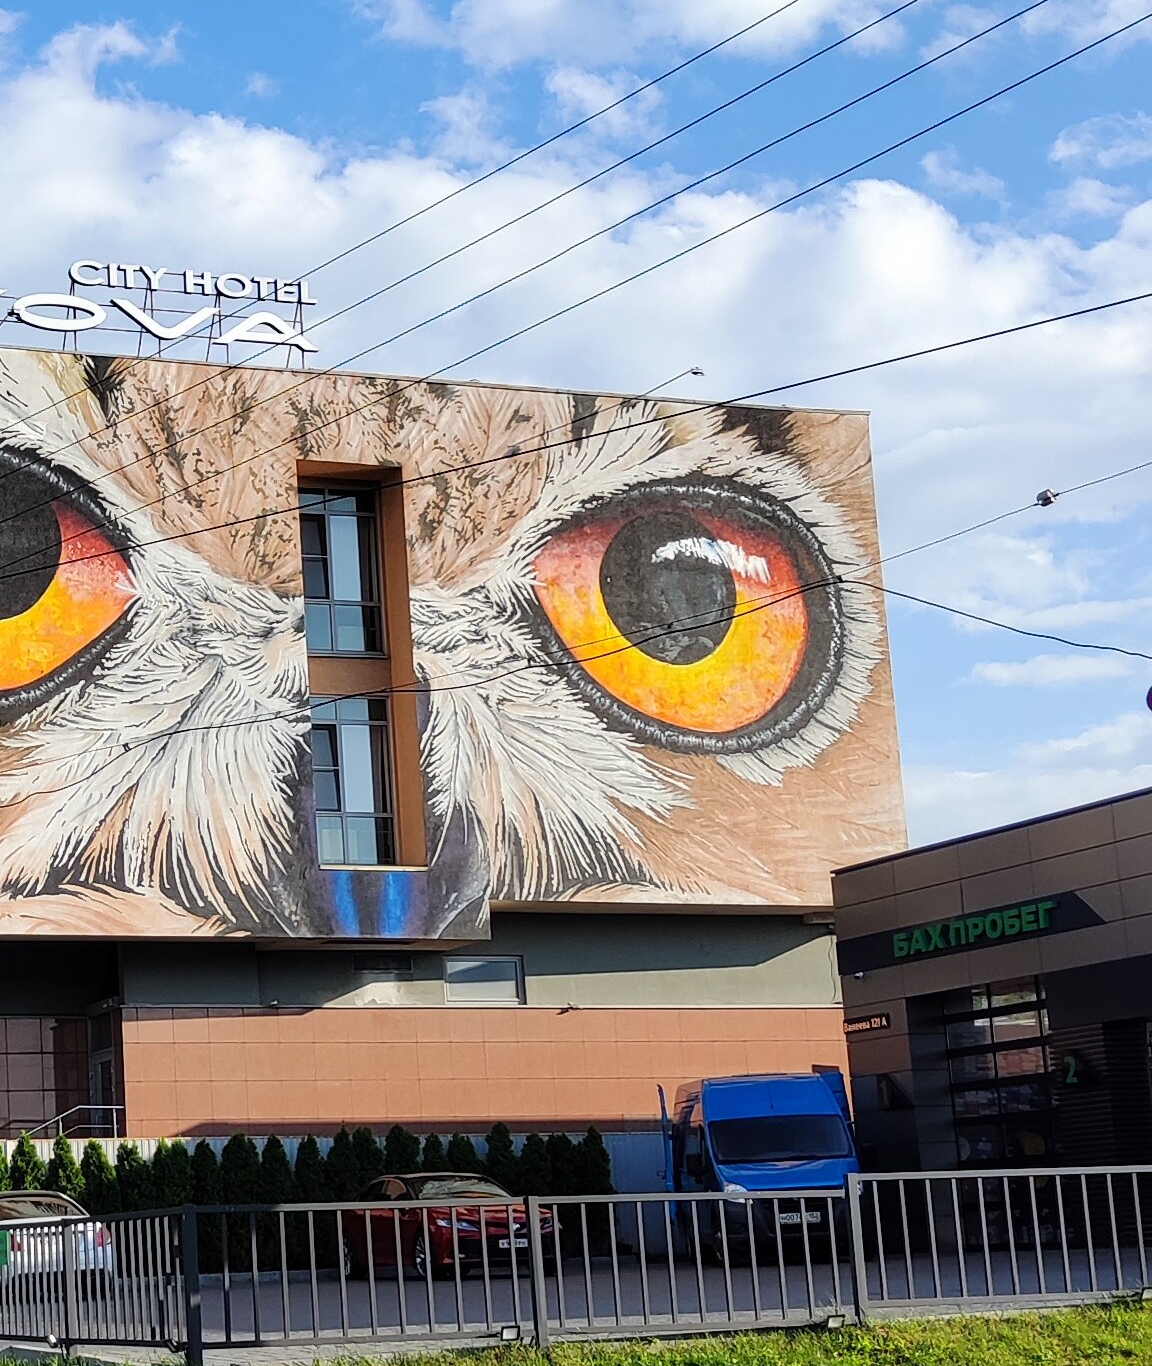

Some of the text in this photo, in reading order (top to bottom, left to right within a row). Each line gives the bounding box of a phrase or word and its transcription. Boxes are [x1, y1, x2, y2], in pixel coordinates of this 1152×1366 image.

[68, 259, 319, 306] CITY HOTEL
[893, 901, 1059, 958] БАХ ПРОБЕГ
[1062, 1056, 1079, 1084] 2
